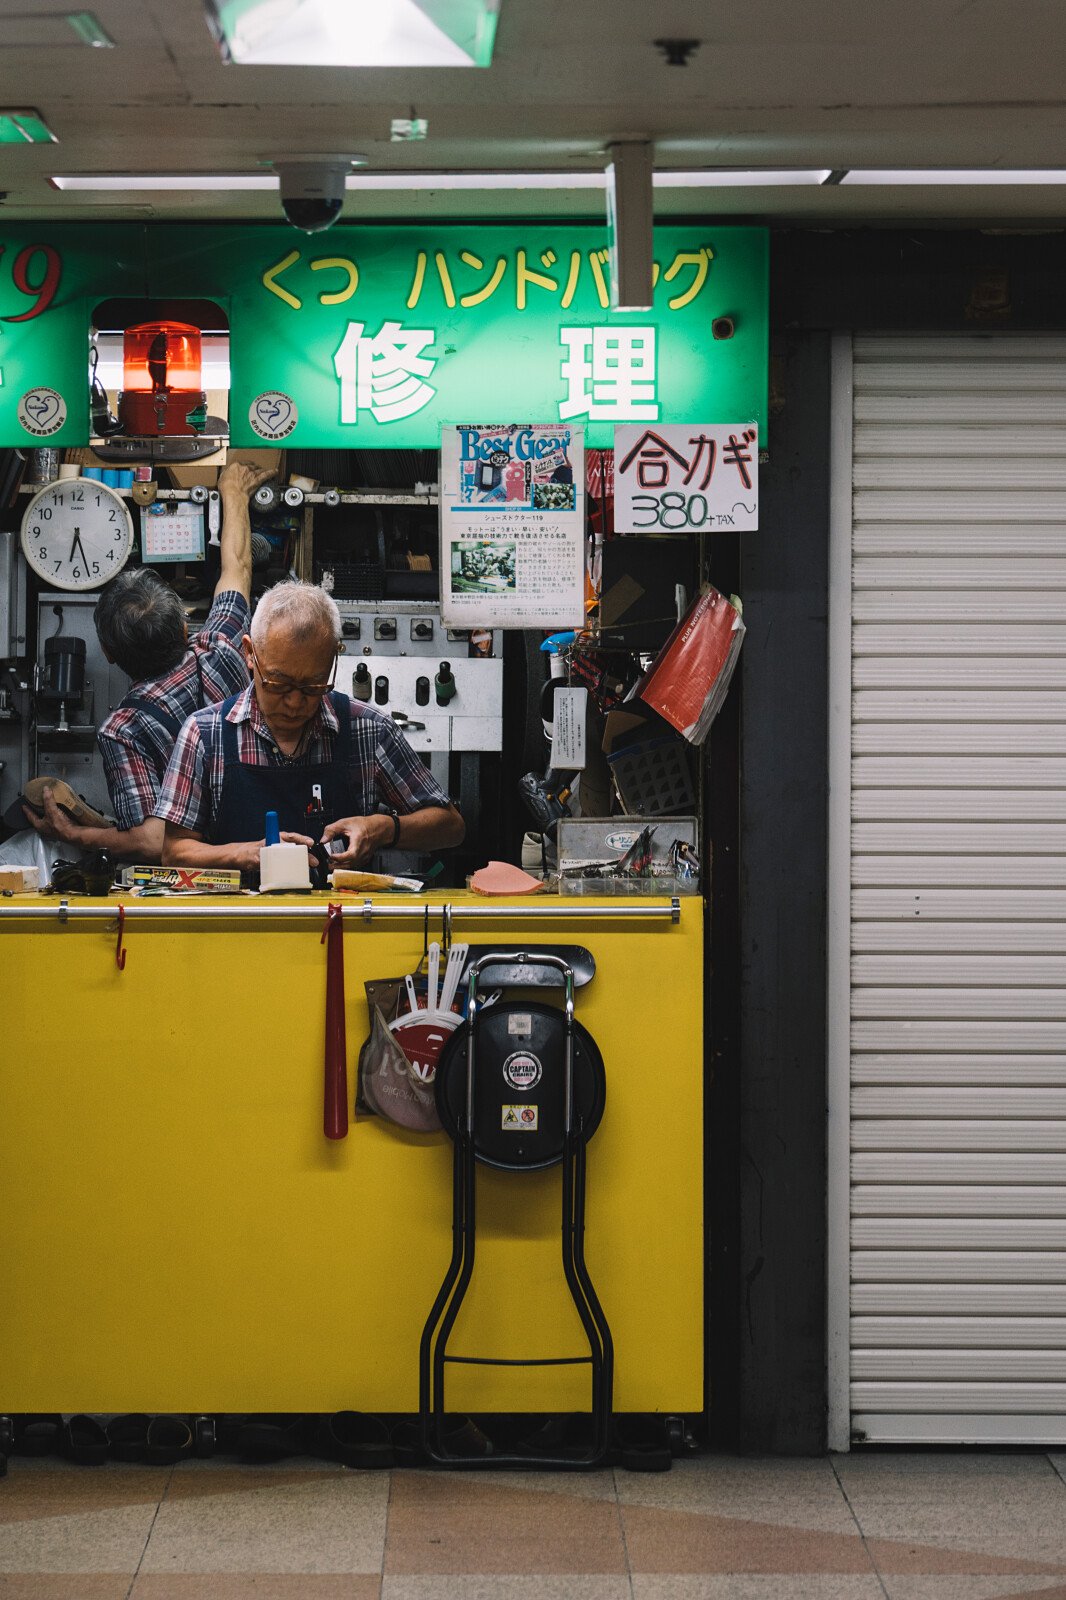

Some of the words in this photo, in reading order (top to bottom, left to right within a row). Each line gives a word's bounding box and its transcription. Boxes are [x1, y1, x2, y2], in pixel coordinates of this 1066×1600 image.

[0, 243, 62, 322] 9
[262, 249, 360, 310] くつ
[407, 247, 716, 311] ハンドバグ
[459, 430, 514, 461] Best
[515, 430, 571, 461] Gear
[619, 429, 756, 491] 合カギ
[52, 494, 64, 506] 11
[71, 490, 84, 501] 12
[95, 495, 100, 507] 1
[38, 508, 52, 520] 10
[108, 509, 116, 522] 2
[32, 526, 41, 539] 9
[114, 528, 121, 541] 3
[40, 547, 48, 559] 8
[105, 549, 114, 561] 4
[54, 560, 62, 573] 7
[72, 566, 81, 578] 6
[92, 561, 100, 574] 5
[509, 1065, 536, 1073] CAPTAIN
